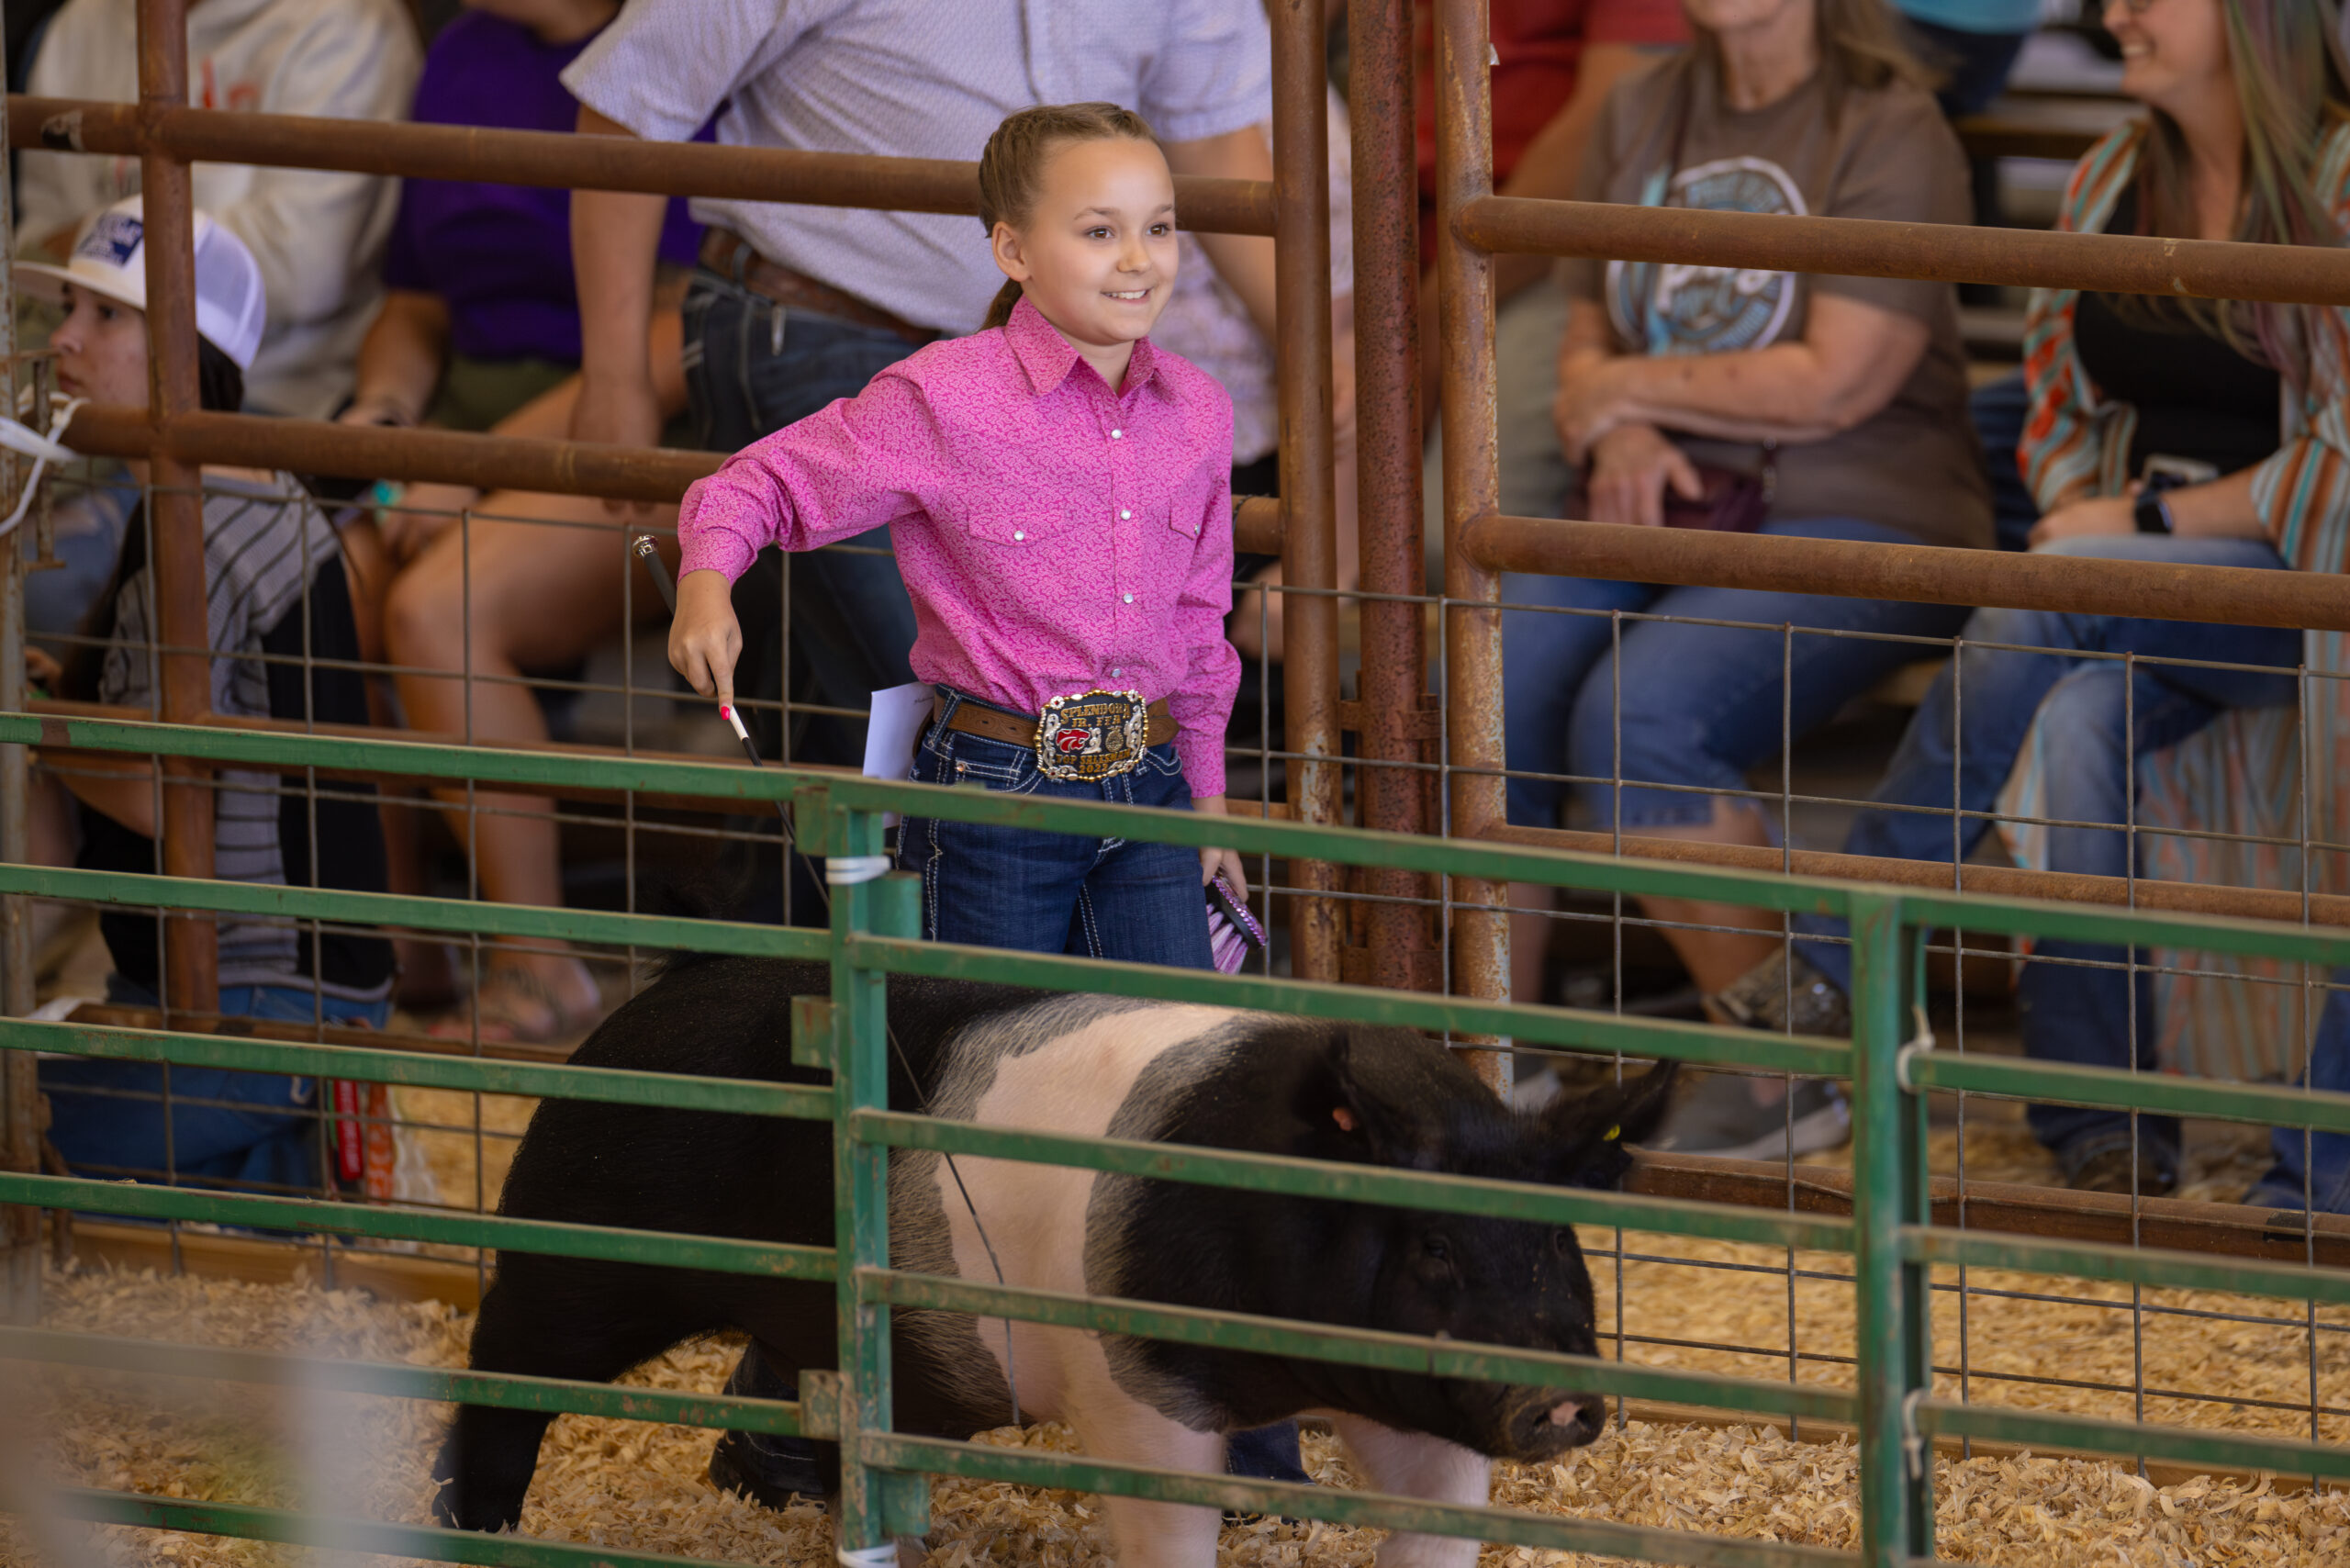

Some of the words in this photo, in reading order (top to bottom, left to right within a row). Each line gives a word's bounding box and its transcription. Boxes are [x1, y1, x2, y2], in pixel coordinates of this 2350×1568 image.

[1060, 703, 1131, 724] SPLENDORA
[1072, 718, 1091, 727] JR.
[1096, 715, 1121, 727] FFA
[1056, 754, 1077, 764] TOP
[1080, 748, 1131, 765] SALESMAN
[1079, 764, 1109, 774] 2022
